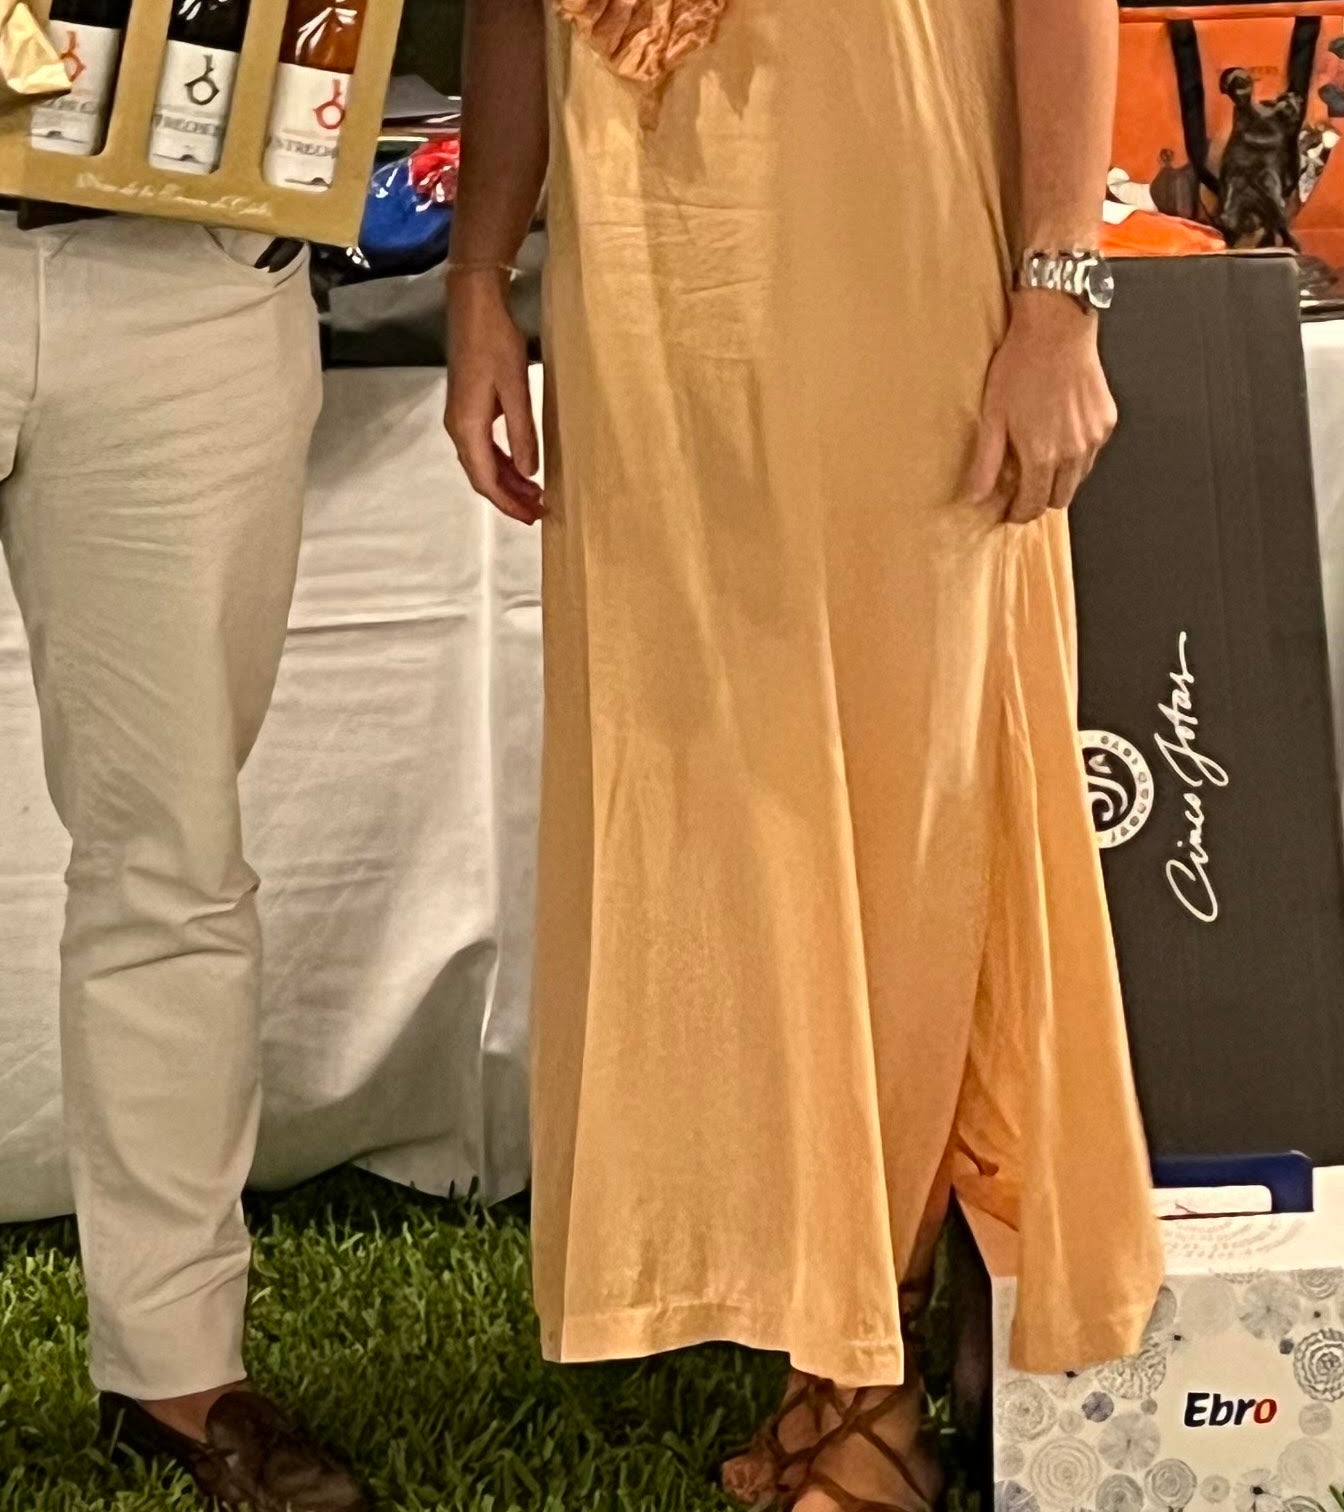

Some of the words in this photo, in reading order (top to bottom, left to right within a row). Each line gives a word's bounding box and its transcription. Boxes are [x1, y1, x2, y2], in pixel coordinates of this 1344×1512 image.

[1154, 630, 1229, 788] Jotas
[1165, 792, 1218, 923] Cinco
[1183, 1391, 1278, 1428] Ebro
